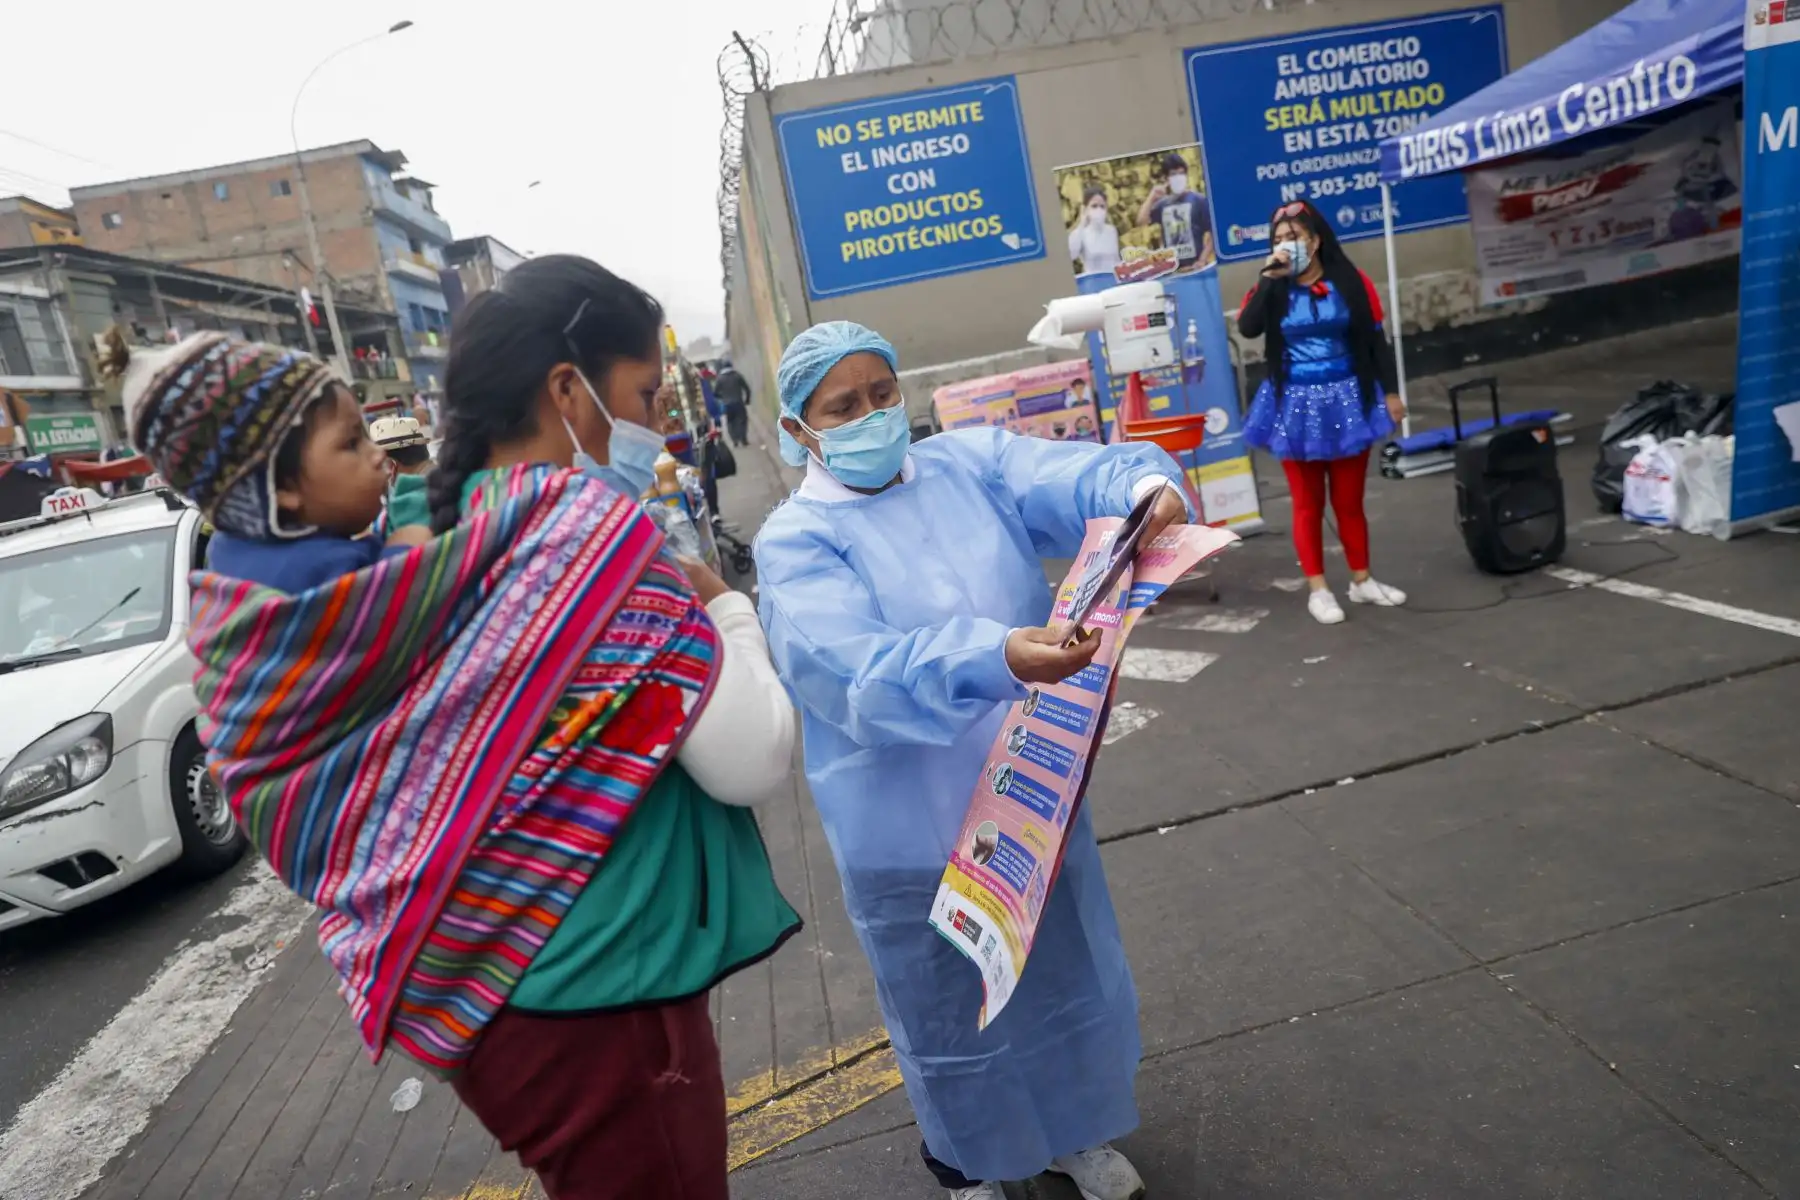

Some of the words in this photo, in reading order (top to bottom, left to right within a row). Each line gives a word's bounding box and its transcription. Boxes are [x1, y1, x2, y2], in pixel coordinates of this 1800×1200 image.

[1277, 54, 1303, 76] EL
[1307, 36, 1421, 71] COMERCIO
[1274, 59, 1429, 101] AMBULATORIO
[816, 124, 852, 148] NO
[856, 118, 884, 141] SE
[887, 101, 984, 136] PERMITE
[1264, 97, 1326, 132] SERÁ
[1331, 83, 1445, 121] MULTADO
[1399, 121, 1469, 178] DIRIS
[1557, 54, 1696, 134] Centro
[841, 151, 868, 173] EL
[872, 133, 970, 168] INGRESO
[1284, 131, 1313, 153] EN
[1317, 122, 1371, 150] ESTA
[887, 168, 936, 194] CON
[1256, 160, 1289, 181] POR
[844, 189, 983, 233] PRODUCTOS
[840, 214, 1003, 263] PIROTÉCNICOS
[33, 430, 50, 447] LA
[48, 494, 86, 513] TAXI
